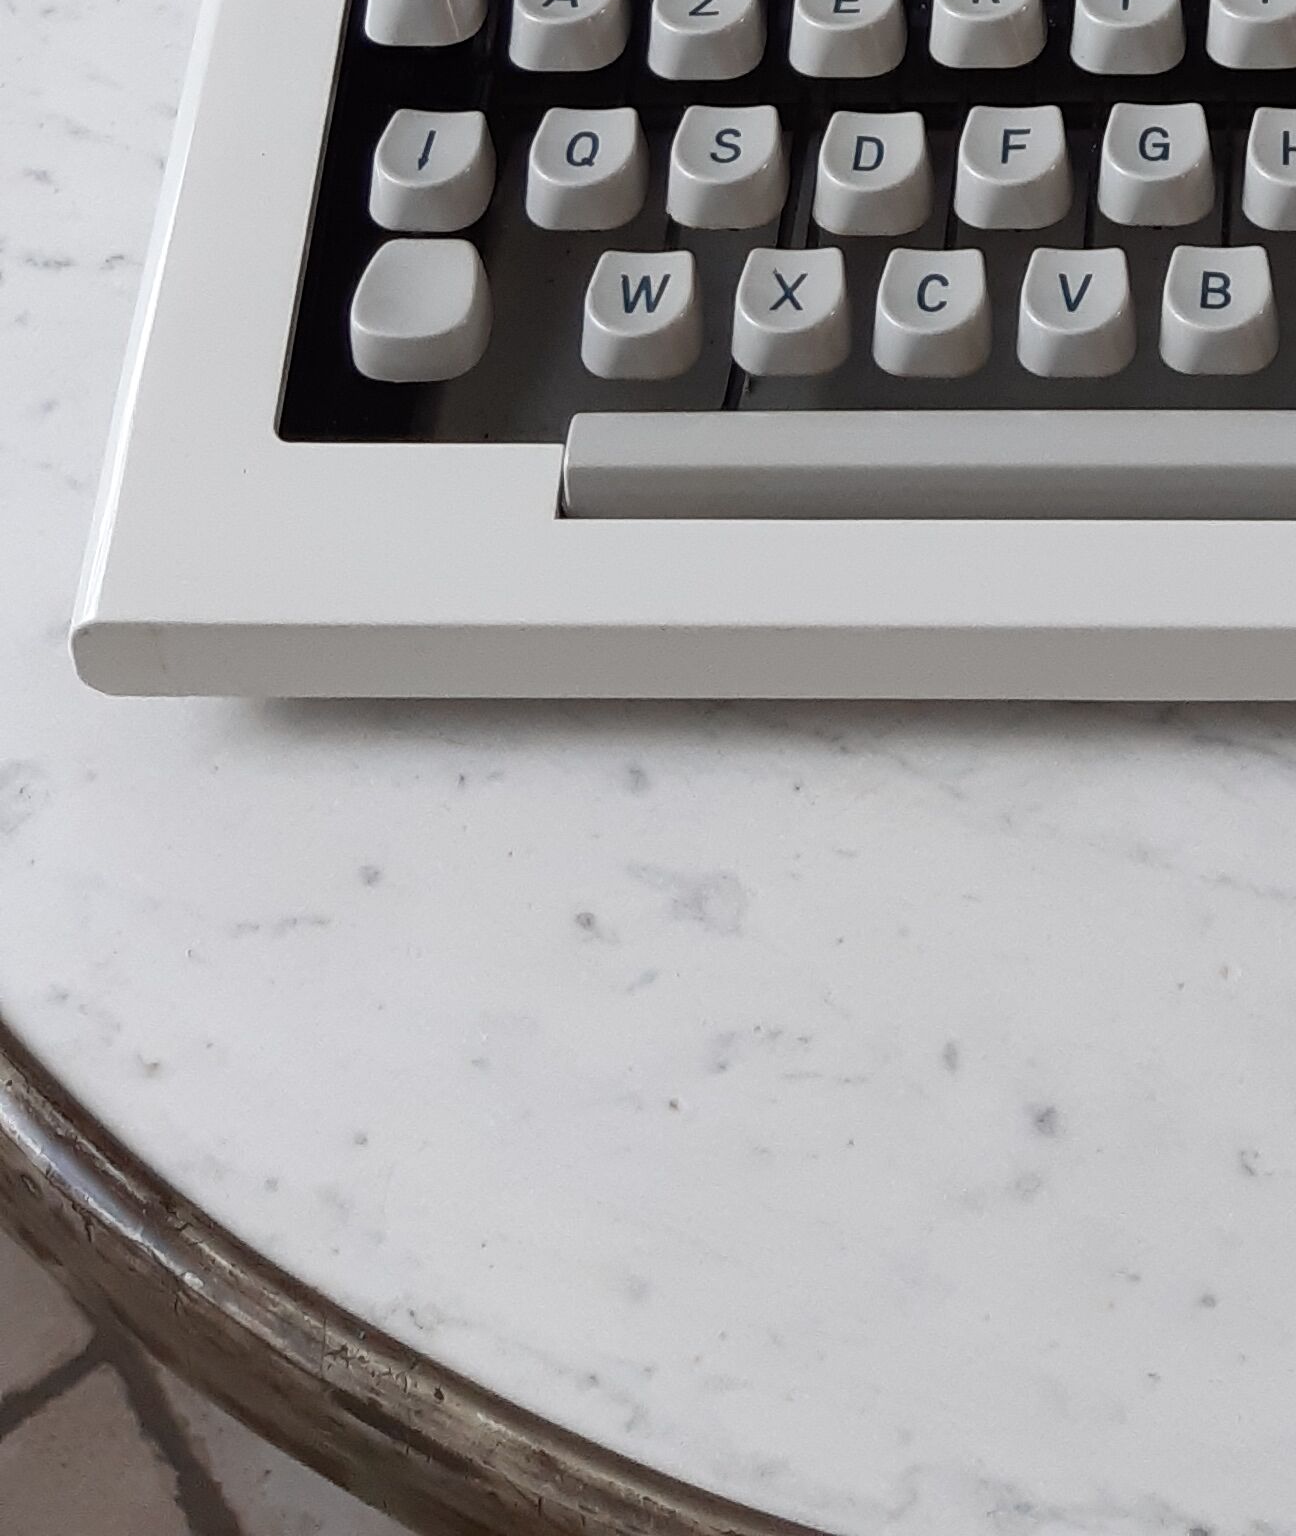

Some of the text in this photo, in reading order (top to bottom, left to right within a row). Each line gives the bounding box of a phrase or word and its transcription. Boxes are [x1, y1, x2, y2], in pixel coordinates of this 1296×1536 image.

[565, 131, 600, 167] Q
[709, 128, 742, 164] S
[852, 135, 885, 172] D
[1000, 128, 1031, 165] F
[1138, 126, 1171, 162] G
[620, 273, 671, 314] W
[768, 270, 808, 312] X
[916, 273, 950, 313] C
[1058, 273, 1093, 313] V
[1199, 270, 1232, 310] B
